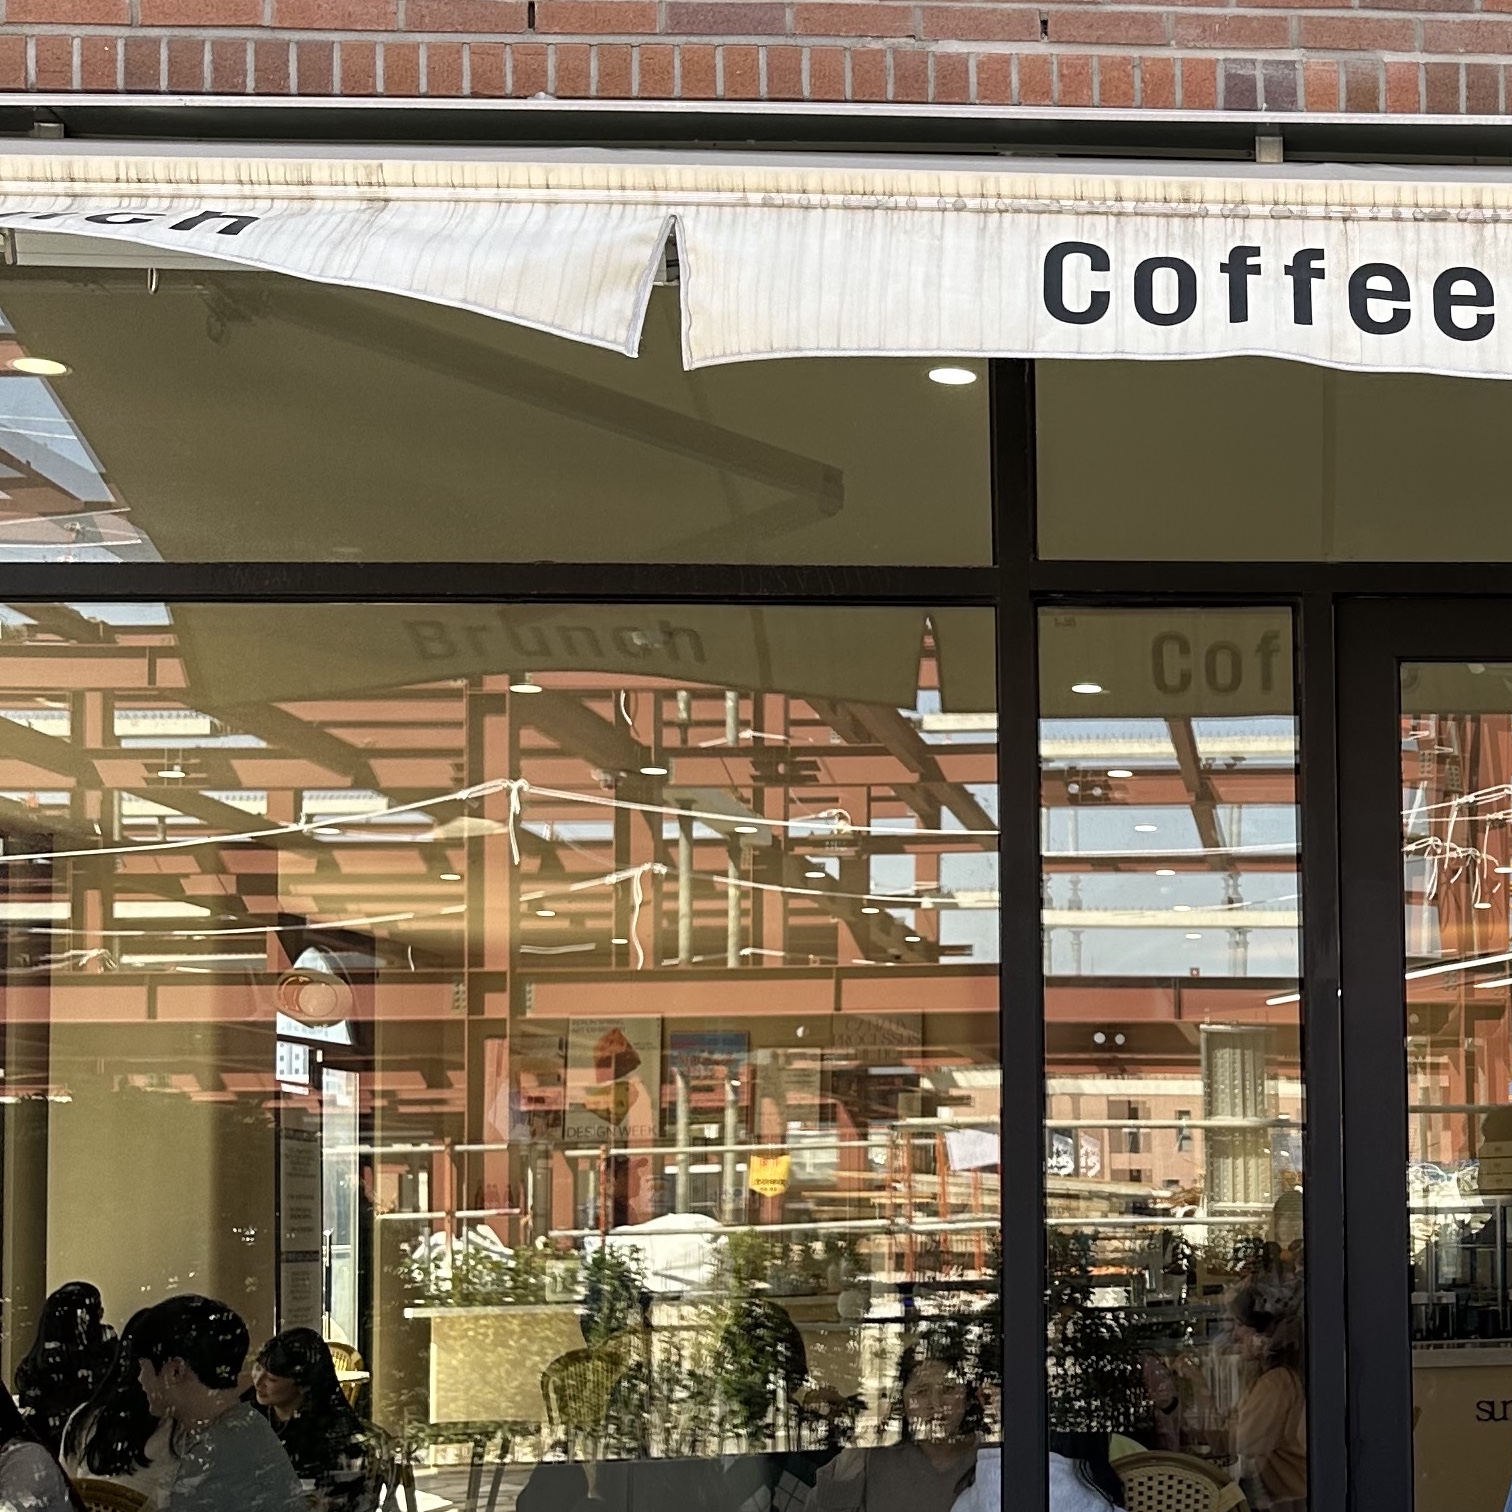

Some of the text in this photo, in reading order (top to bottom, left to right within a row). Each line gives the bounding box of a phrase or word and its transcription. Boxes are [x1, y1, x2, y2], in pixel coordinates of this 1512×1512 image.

[1043, 241, 1495, 341] Coffee
[566, 1125, 657, 1138] DESIGN WEEK
